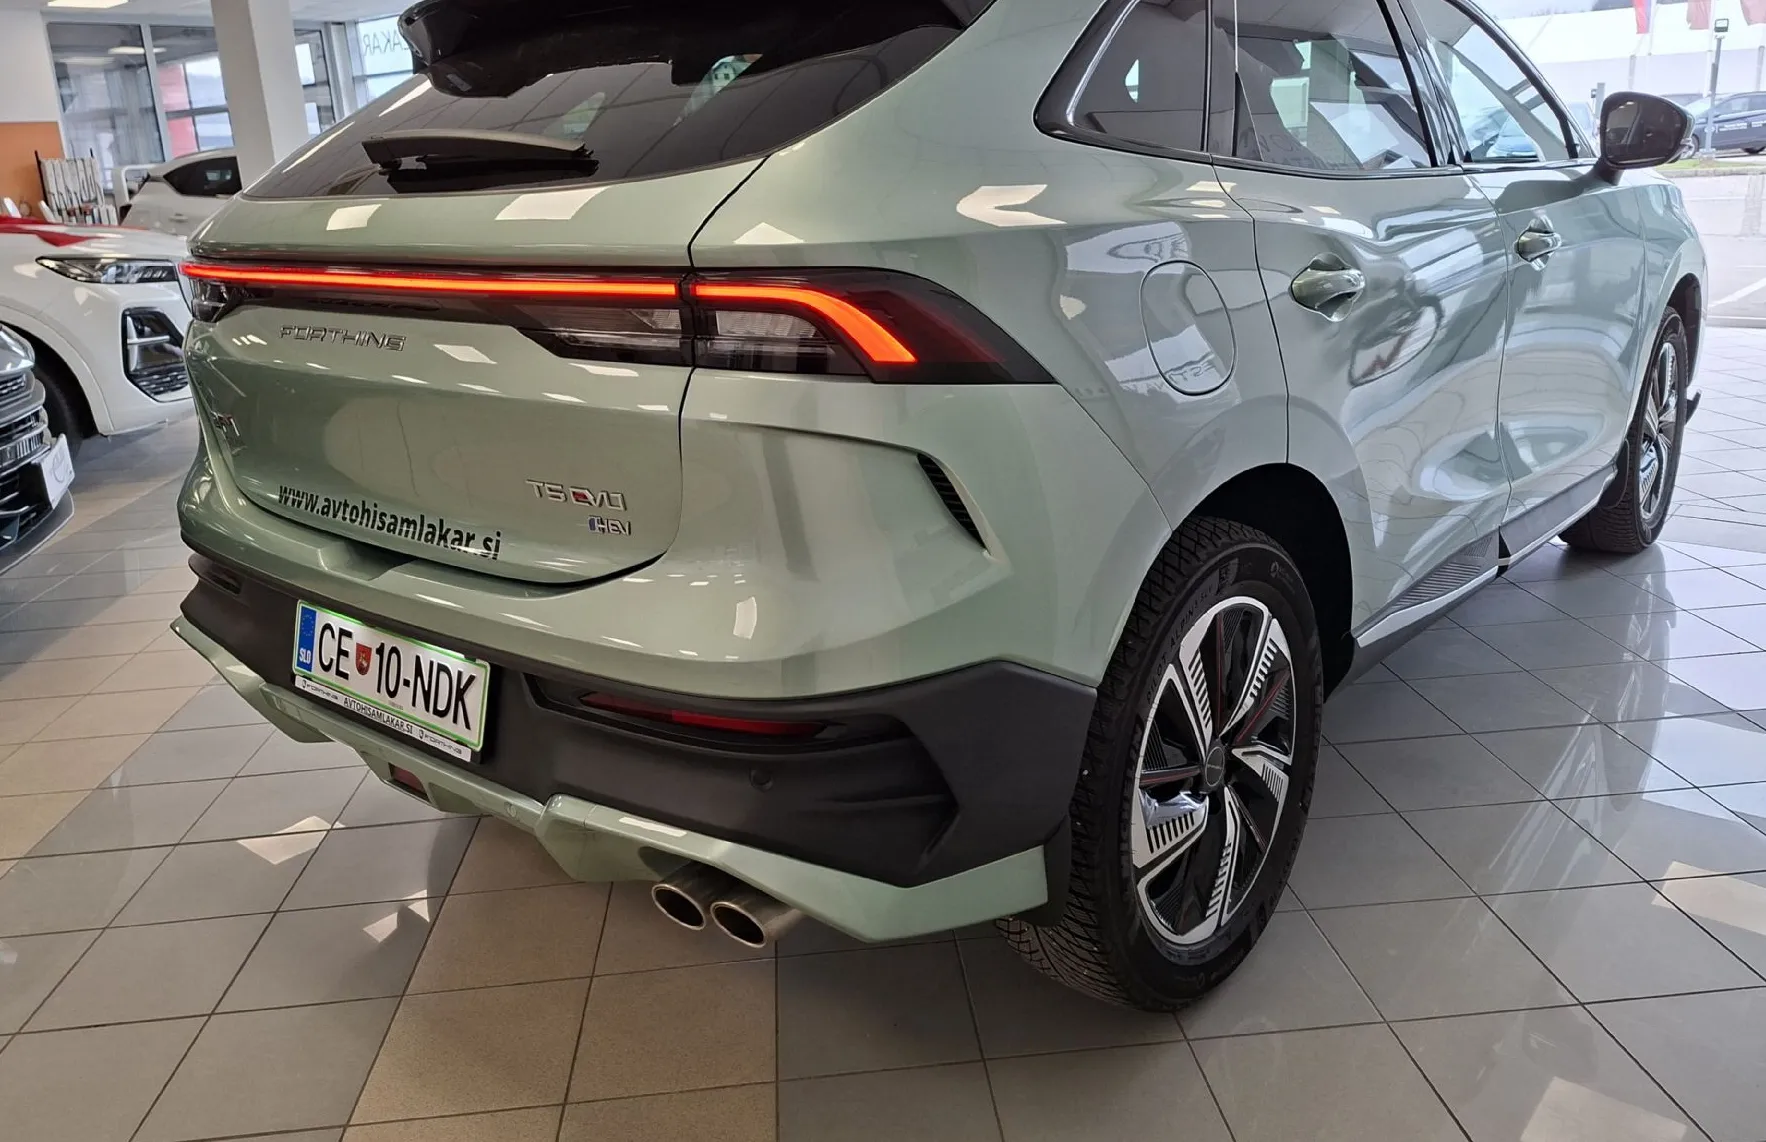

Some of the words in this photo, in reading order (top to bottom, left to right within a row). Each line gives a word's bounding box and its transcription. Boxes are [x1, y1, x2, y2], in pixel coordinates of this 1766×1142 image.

[279, 325, 407, 352] FORTHING
[525, 479, 568, 502] T5
[278, 485, 501, 561] www.avtohisamlakar.si
[596, 516, 632, 535] HEV
[299, 647, 312, 665] SLO
[318, 622, 353, 681] CE
[375, 642, 476, 731] 10-NDK
[343, 697, 413, 734] AVTOHISAMLAKAR.SI
